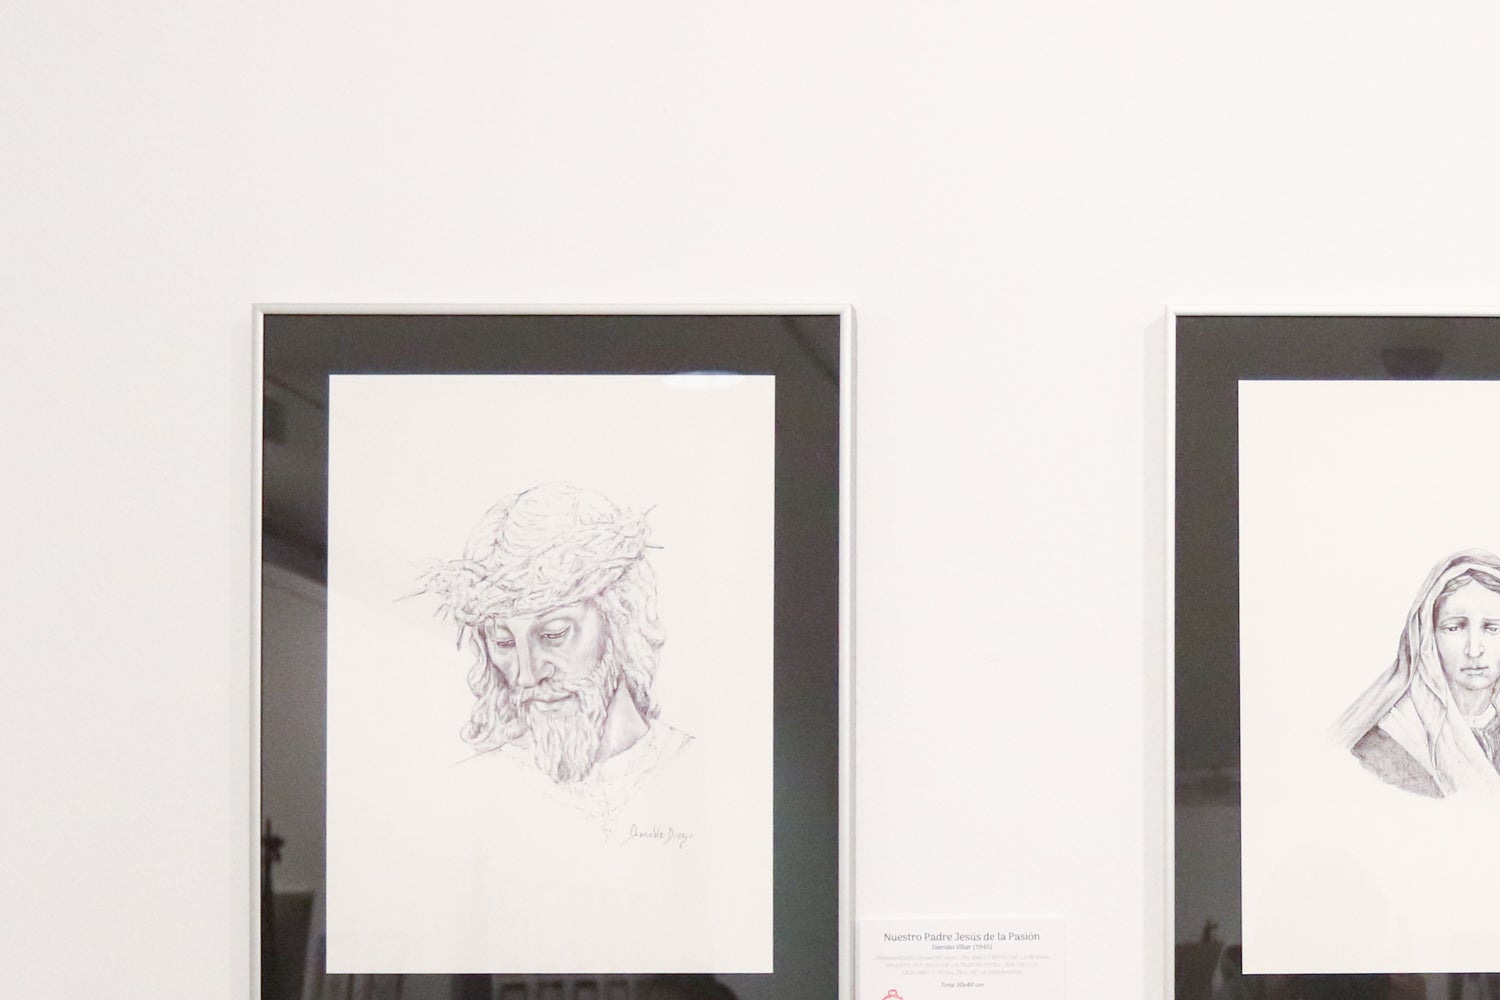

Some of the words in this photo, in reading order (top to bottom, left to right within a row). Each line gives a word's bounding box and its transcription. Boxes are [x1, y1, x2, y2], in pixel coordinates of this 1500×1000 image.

[884, 933, 922, 941] Nuestro
[924, 932, 953, 941] Padre
[954, 932, 982, 942] Jesús
[983, 933, 996, 941] de
[997, 933, 1006, 941] la
[1008, 932, 1040, 941] Pasión
